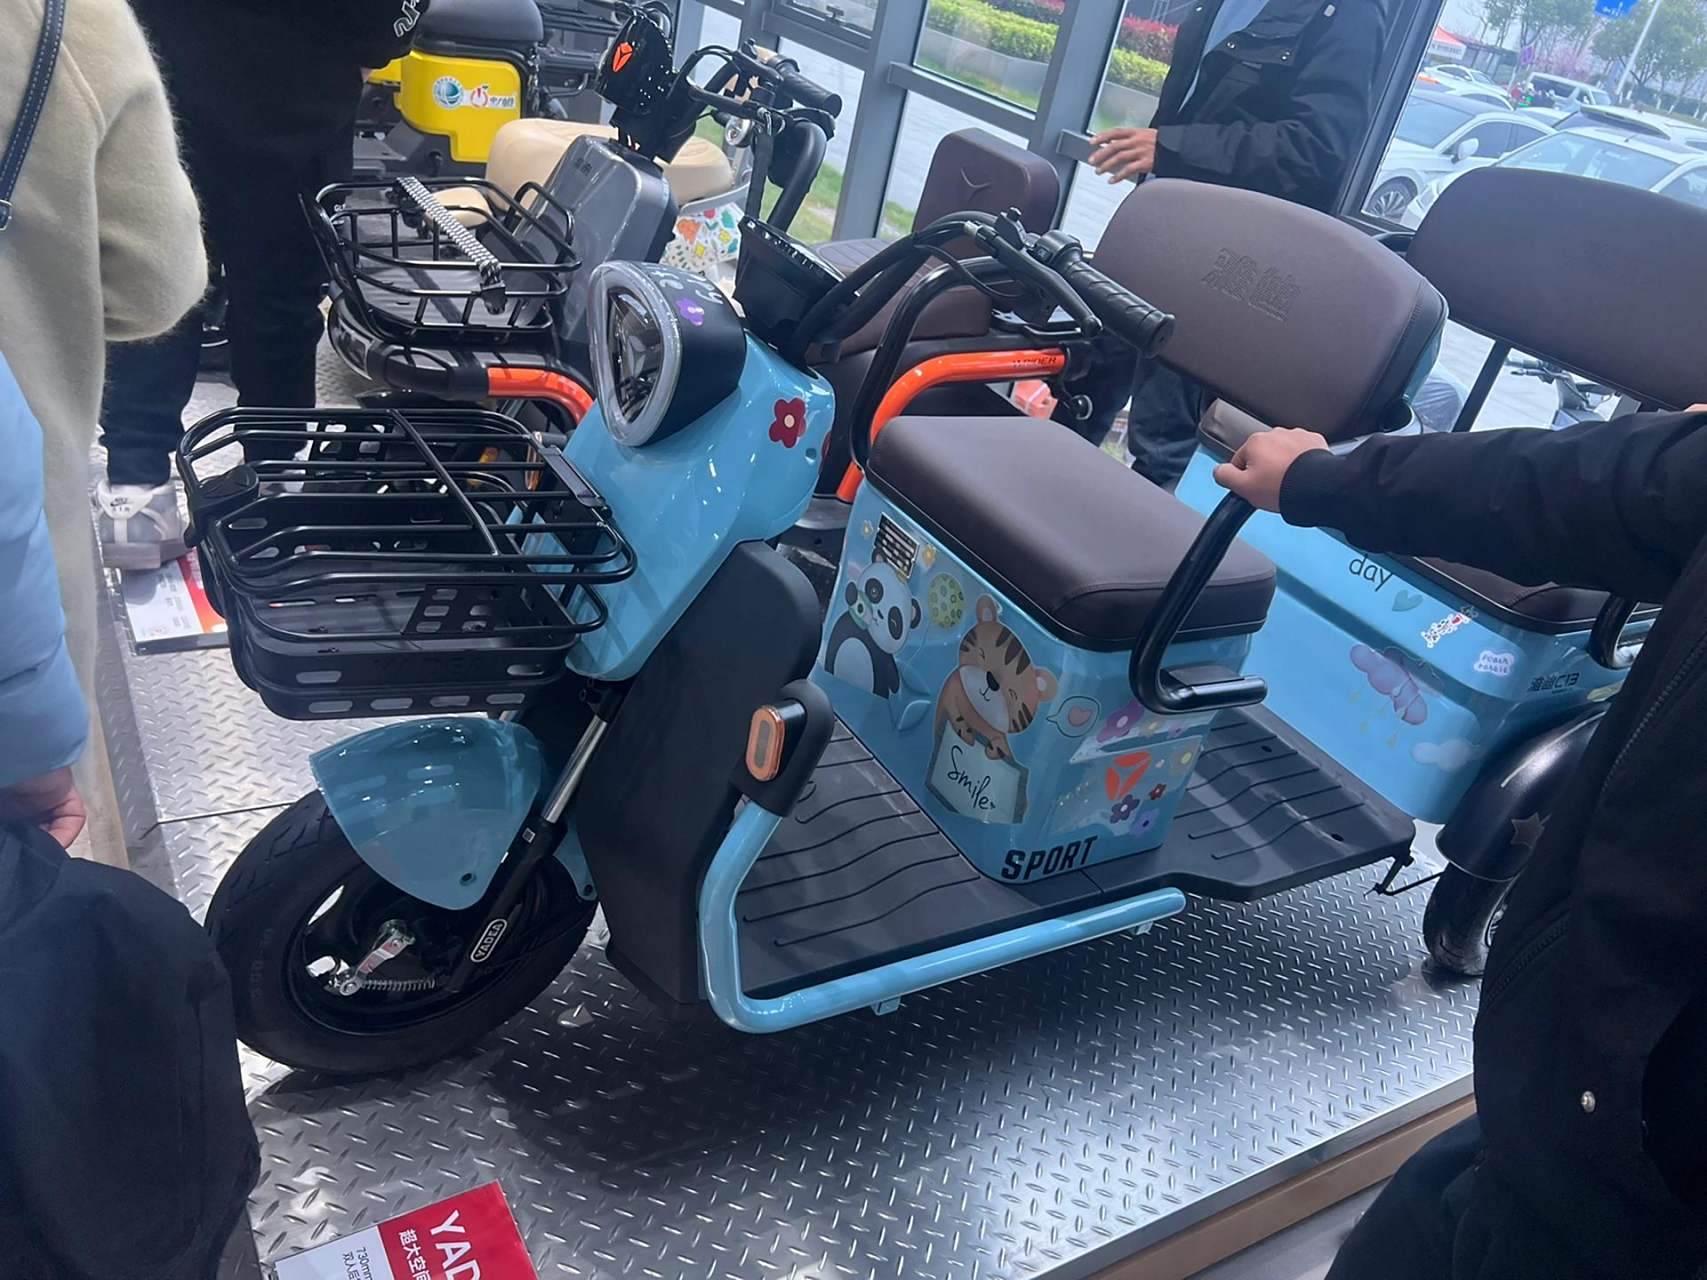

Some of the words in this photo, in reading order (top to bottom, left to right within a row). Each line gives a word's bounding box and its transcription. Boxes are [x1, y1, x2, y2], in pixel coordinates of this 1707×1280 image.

[1348, 553, 1394, 593] day
[947, 744, 992, 811] Smile
[1001, 835, 1098, 880] SPORT
[473, 921, 505, 960] YADEA
